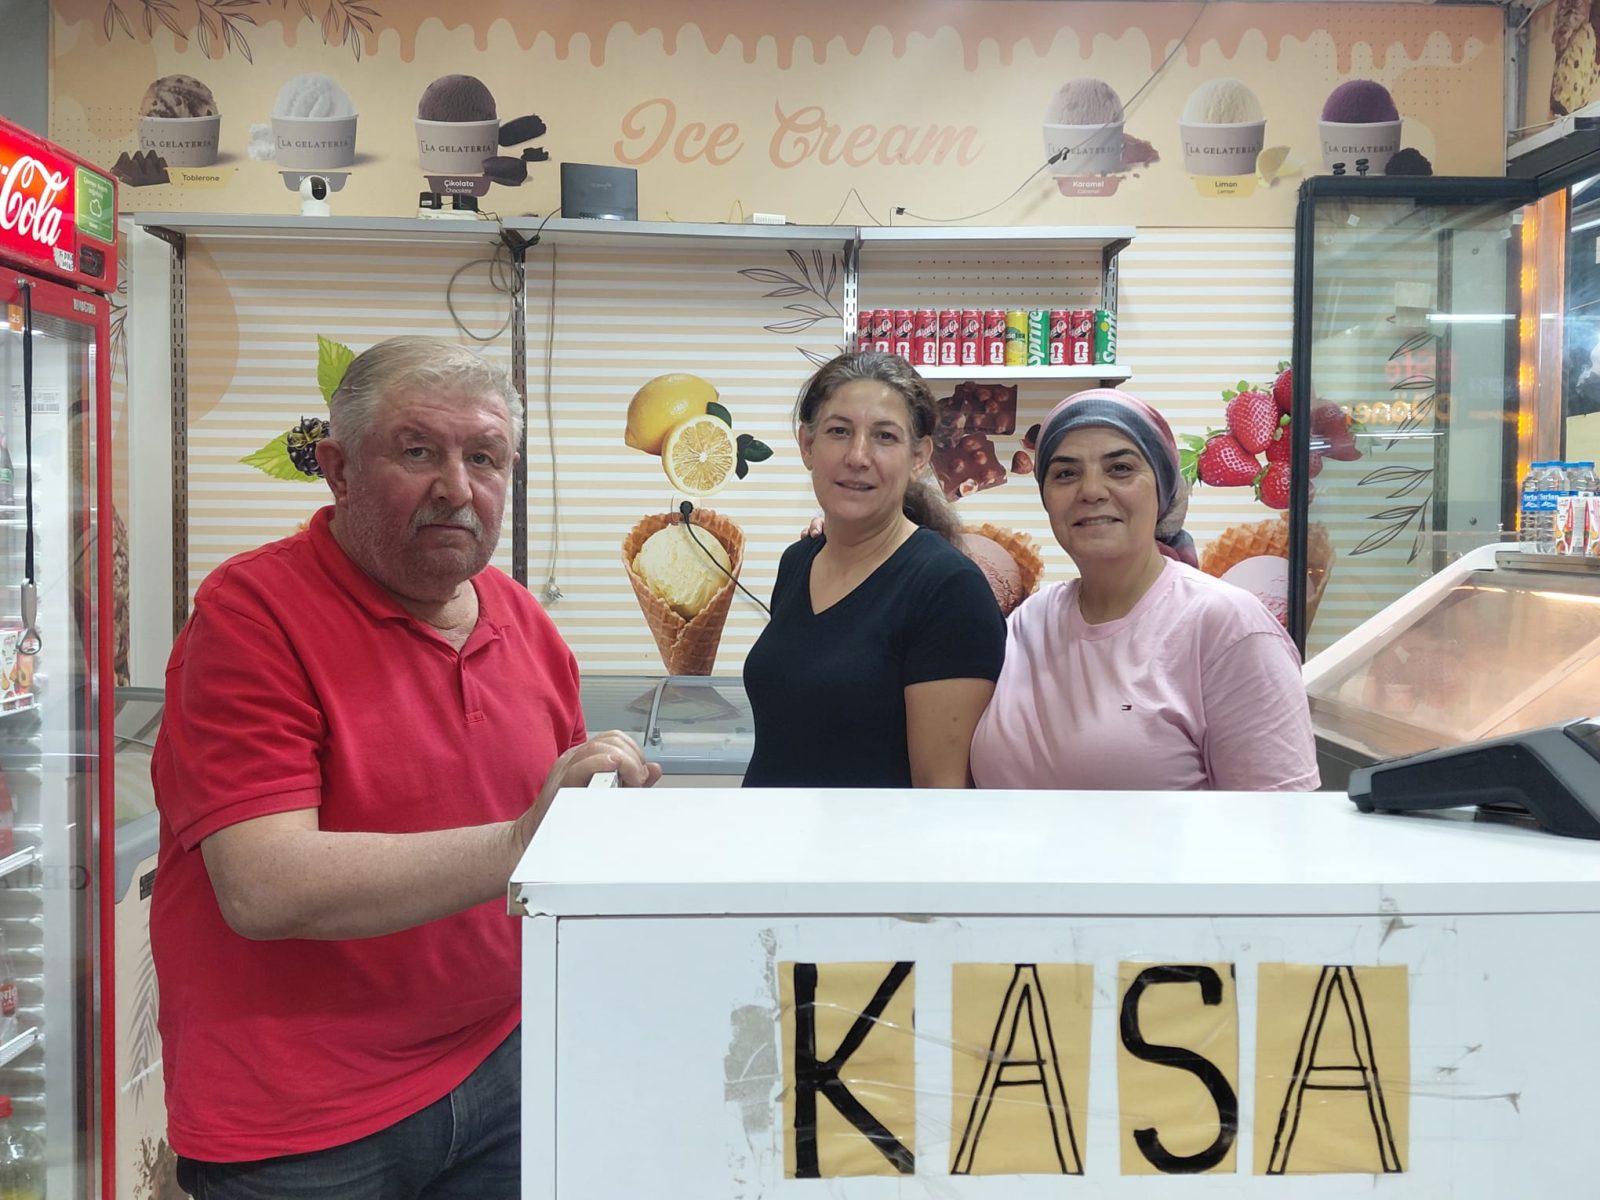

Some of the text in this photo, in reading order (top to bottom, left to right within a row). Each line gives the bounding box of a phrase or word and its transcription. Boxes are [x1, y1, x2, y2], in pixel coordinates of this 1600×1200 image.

[614, 97, 984, 169] Ice Cream
[159, 140, 212, 148] GELATERIA
[295, 140, 349, 149] GELATERIA
[438, 144, 491, 153] GELATERIA
[1203, 146, 1256, 155] GELATERIA
[183, 174, 220, 182] Toblerone
[444, 179, 474, 188] Çikolata
[1072, 180, 1104, 188] Karamel
[1215, 180, 1238, 188] Limon
[794, 961, 1402, 1178] KASA
